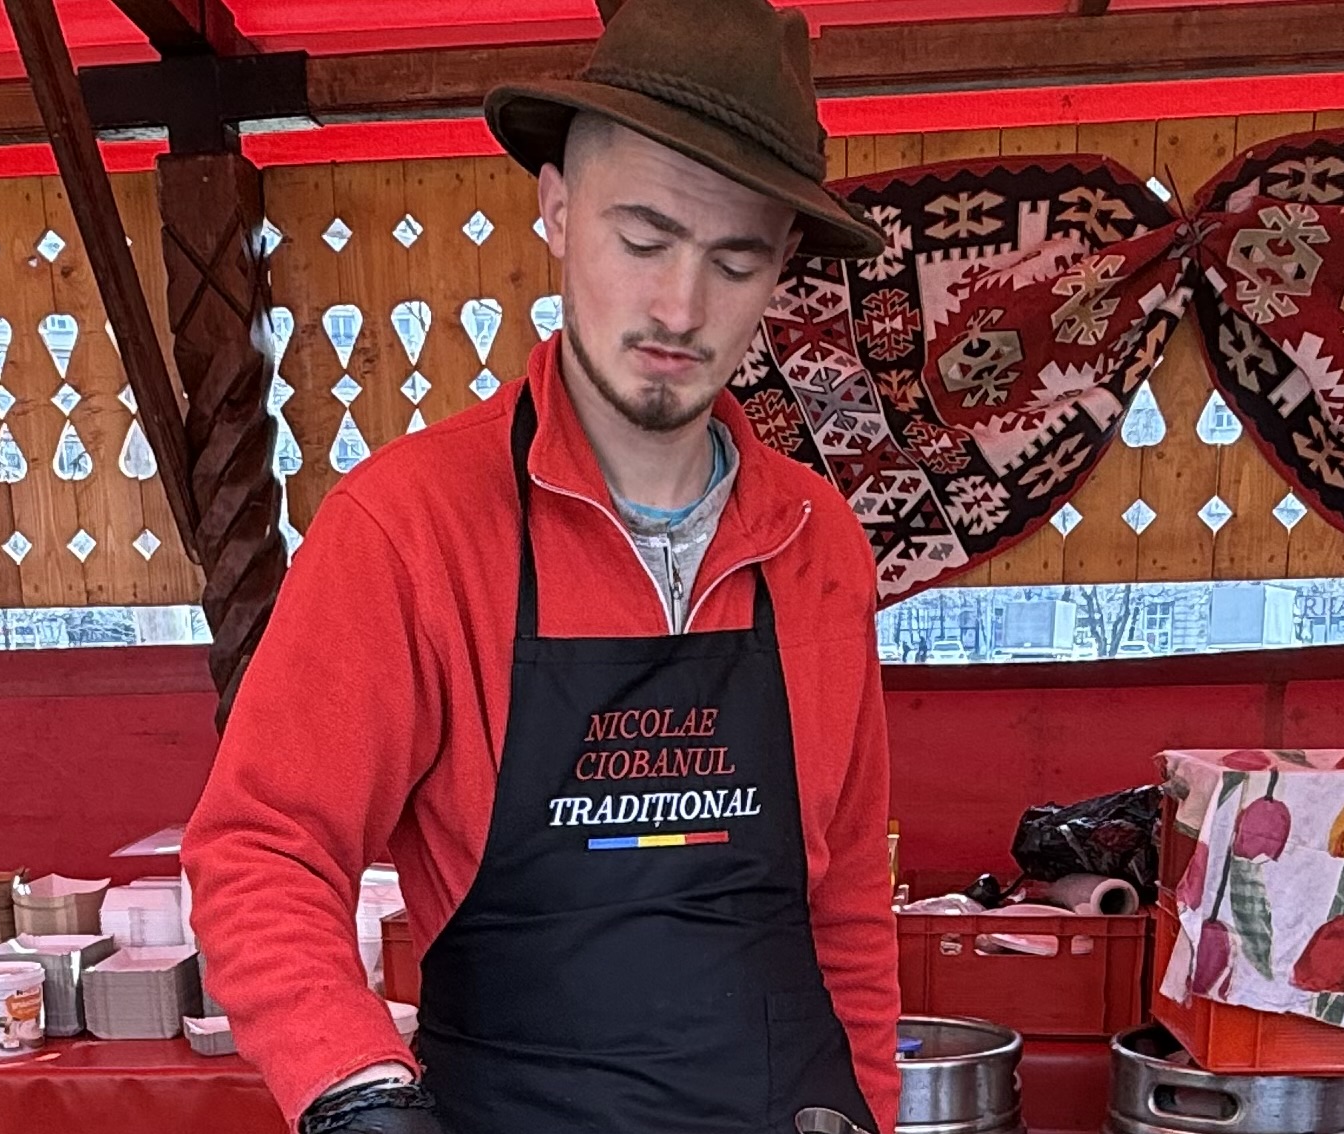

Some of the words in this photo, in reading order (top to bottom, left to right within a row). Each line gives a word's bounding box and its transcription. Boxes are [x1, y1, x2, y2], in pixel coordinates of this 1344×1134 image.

[585, 708, 718, 741] NICOLAE
[576, 748, 735, 780] CIOBANUL
[549, 787, 762, 827] TRADIȚIONAL
